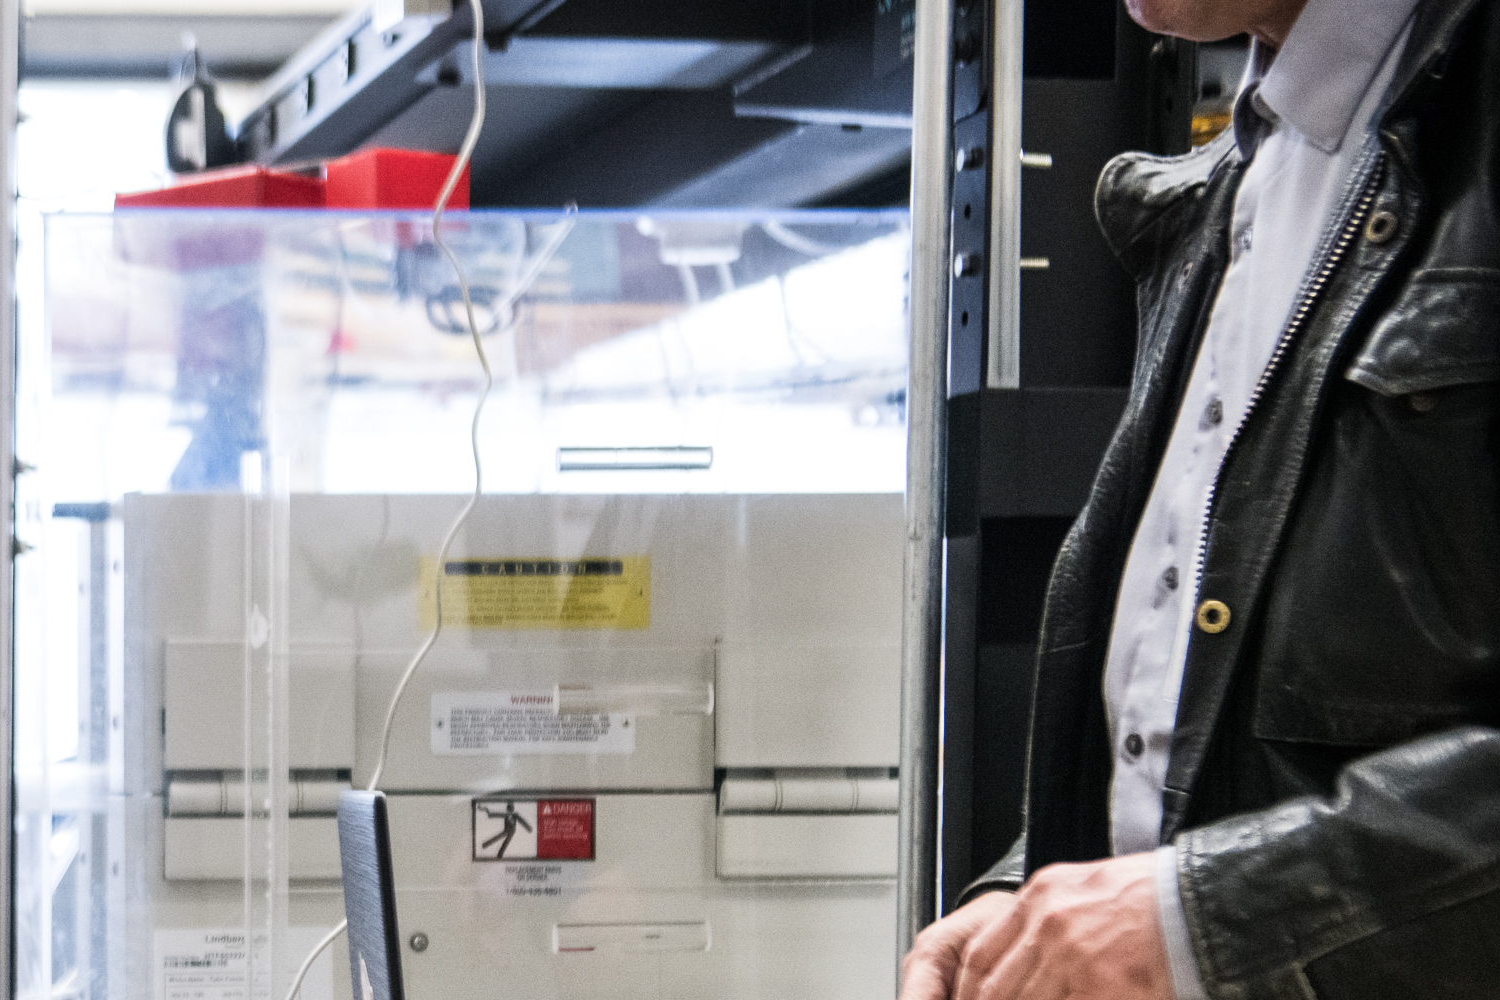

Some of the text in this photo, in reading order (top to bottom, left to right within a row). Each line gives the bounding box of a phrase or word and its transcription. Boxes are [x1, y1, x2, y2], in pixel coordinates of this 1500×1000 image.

[481, 562, 587, 575] CAUTION
[510, 694, 554, 705] WARNIN
[553, 802, 592, 815] DANGER
